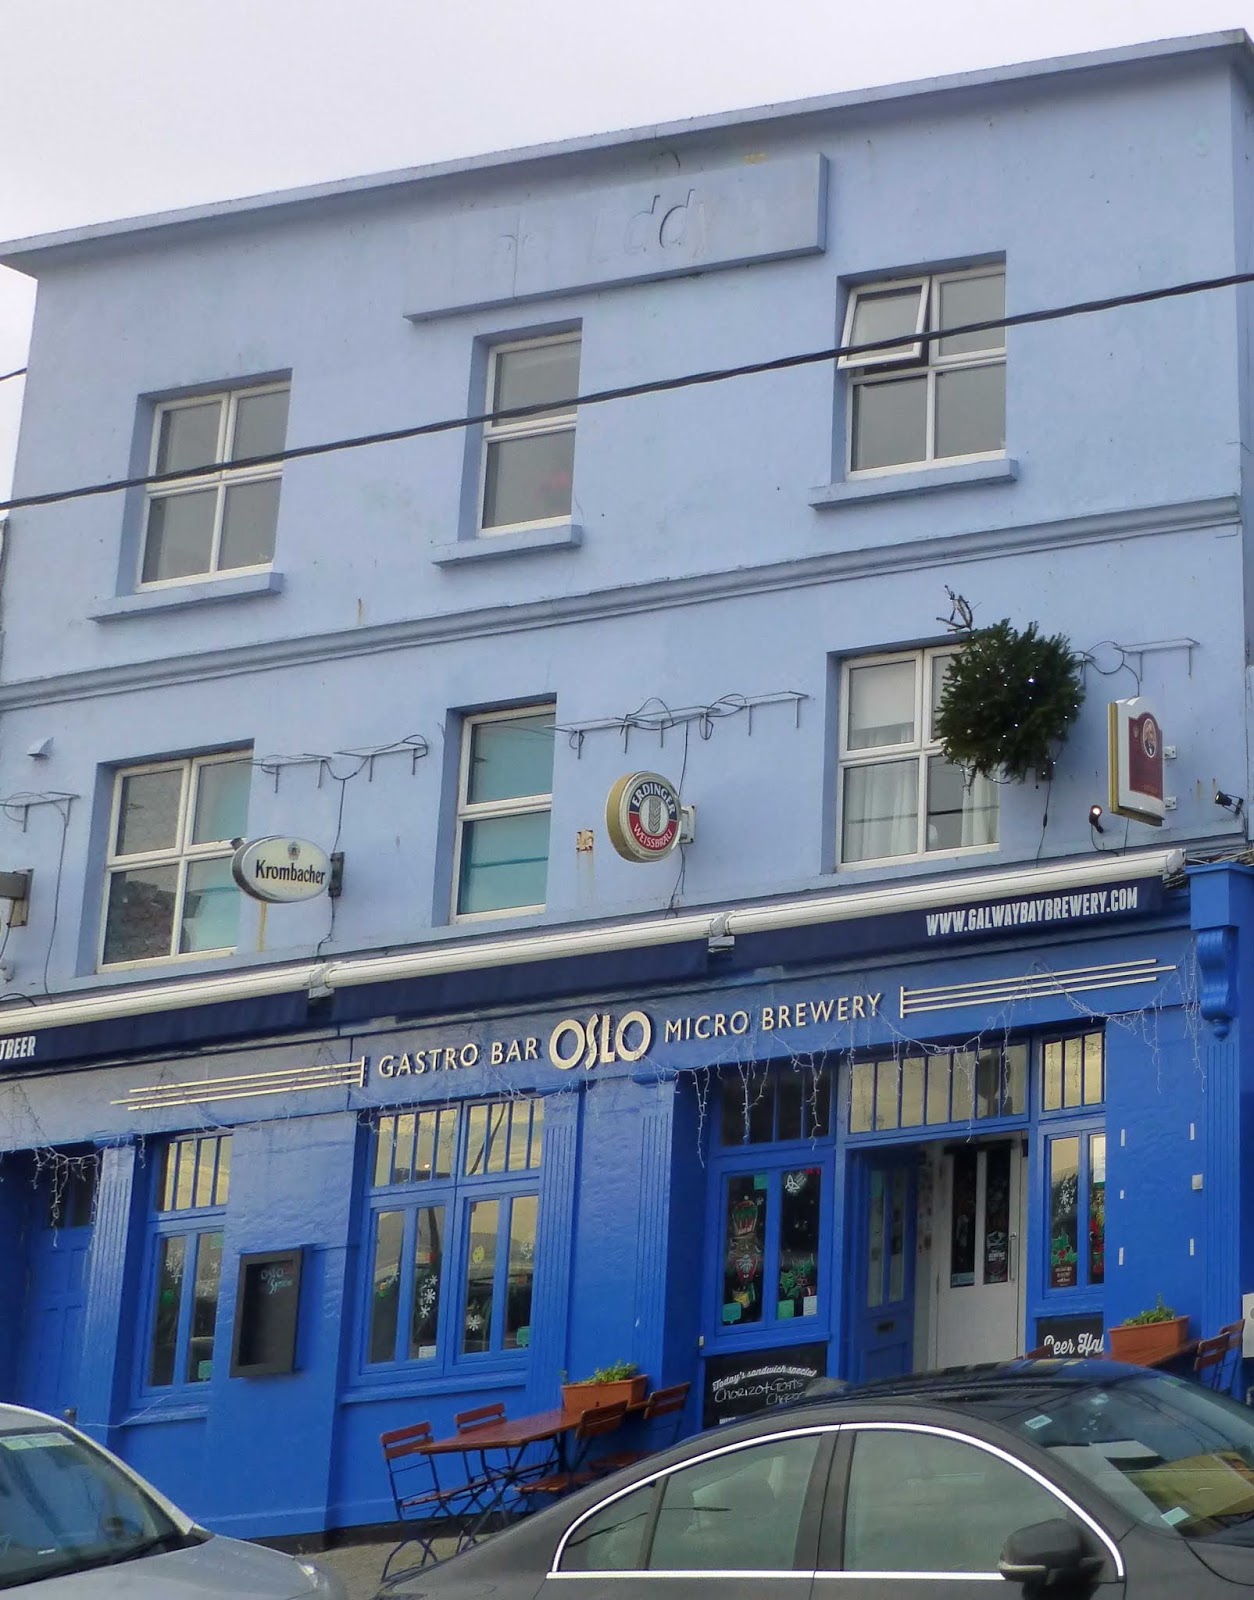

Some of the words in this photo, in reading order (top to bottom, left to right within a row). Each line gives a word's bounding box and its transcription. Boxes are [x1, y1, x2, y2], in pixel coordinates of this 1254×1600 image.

[632, 783, 675, 814] ERDINGER
[255, 859, 327, 885] Krombacher
[926, 887, 1138, 936] WWW.GALWAYBAYBREWERY.COM
[378, 1043, 479, 1078] GASTRO
[491, 1037, 538, 1065] BAR
[549, 1010, 652, 1070] OSLO
[664, 1010, 749, 1043] MICRO
[762, 992, 881, 1031] BREWERY
[712, 1371, 746, 1391] Today's
[747, 1365, 786, 1378] sandwich
[787, 1366, 818, 1377] special
